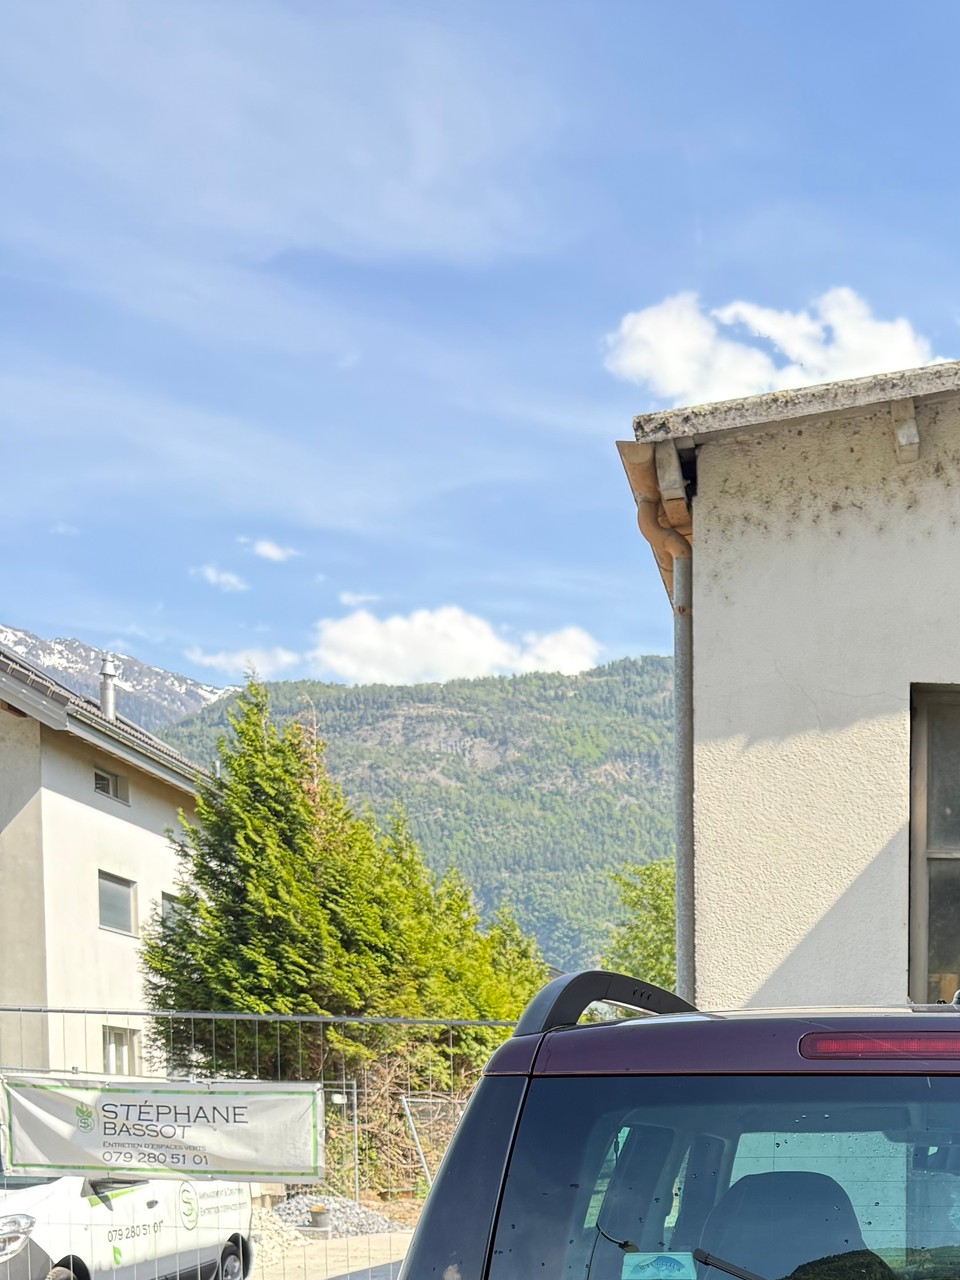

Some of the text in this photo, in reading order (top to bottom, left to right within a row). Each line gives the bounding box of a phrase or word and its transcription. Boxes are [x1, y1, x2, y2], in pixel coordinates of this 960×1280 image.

[101, 1100, 248, 1124] STÉPHANE
[103, 1121, 191, 1139] BASSOT
[102, 1151, 208, 1166] 079 280 51 01
[107, 1228, 123, 1243] 079
[125, 1225, 141, 1240] 280
